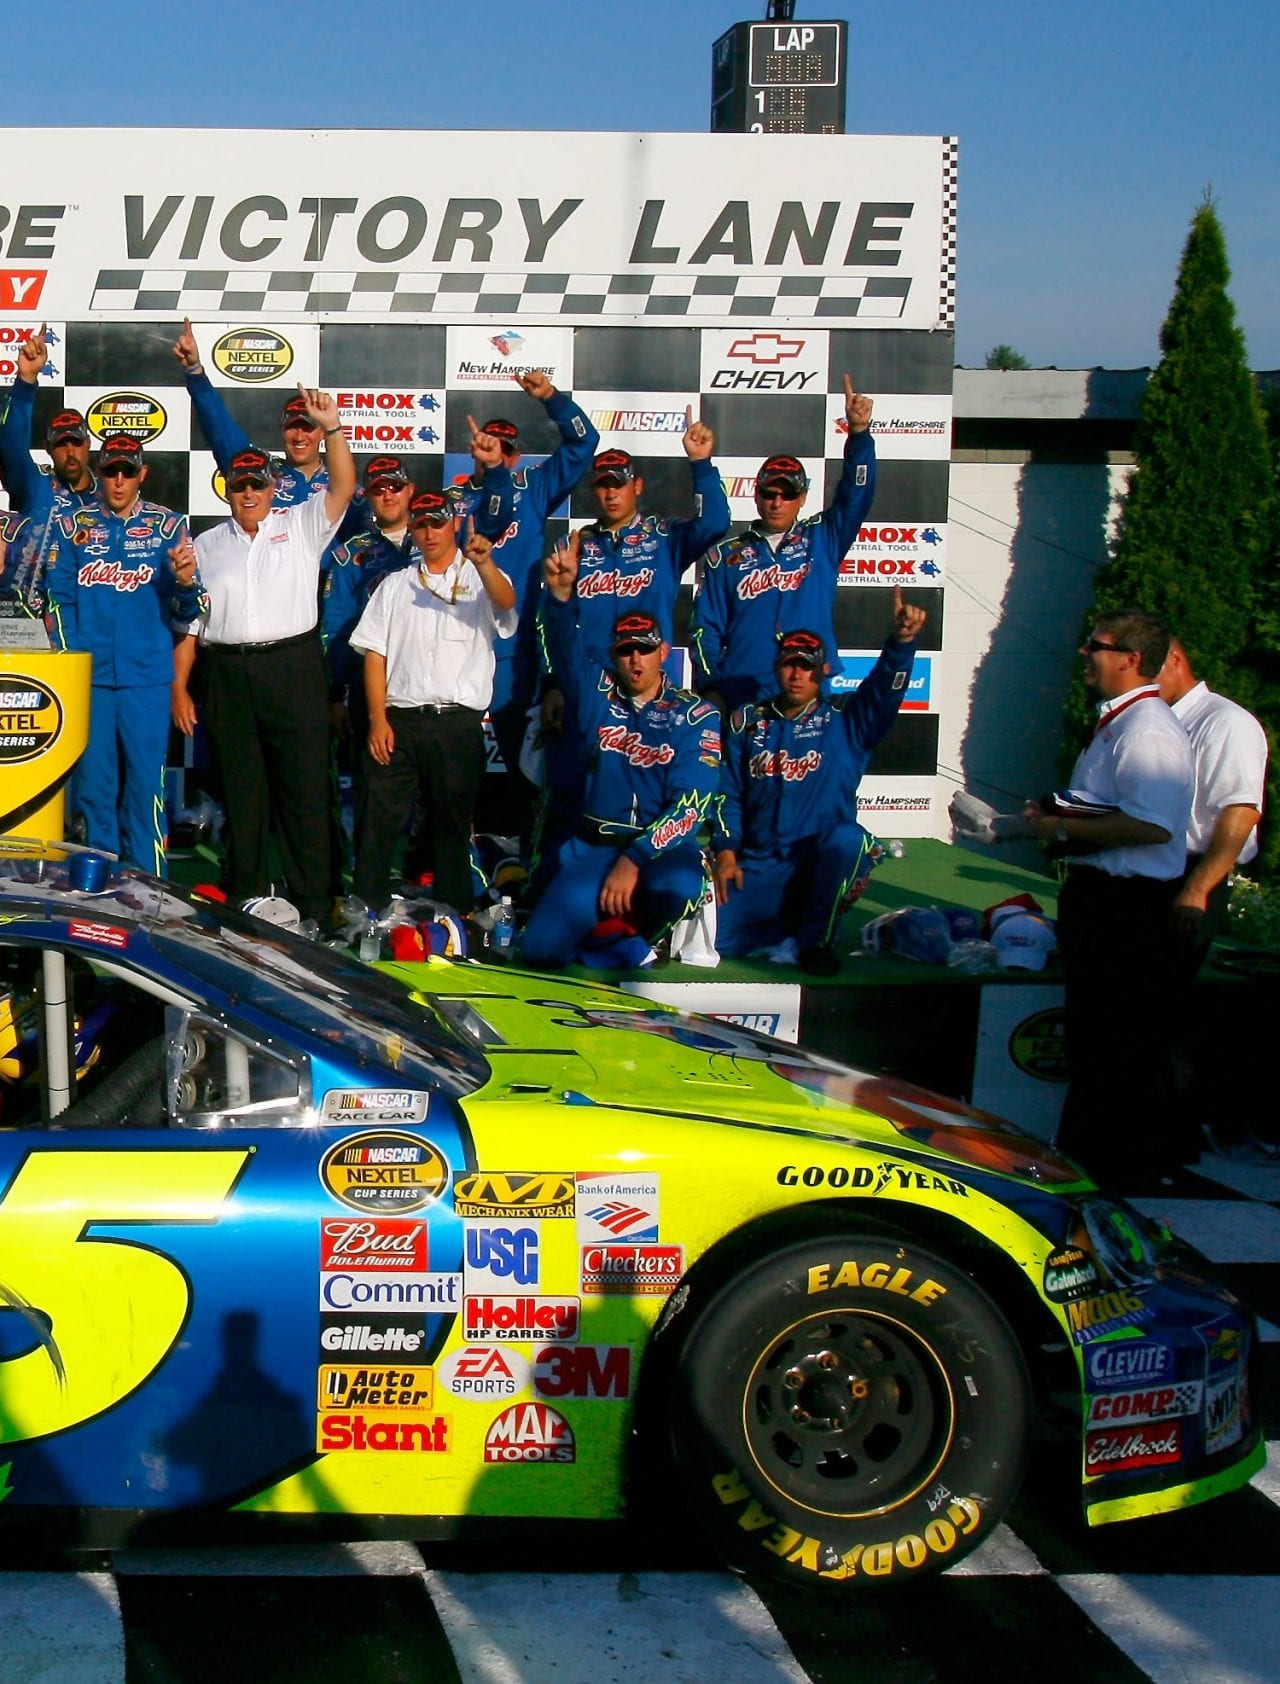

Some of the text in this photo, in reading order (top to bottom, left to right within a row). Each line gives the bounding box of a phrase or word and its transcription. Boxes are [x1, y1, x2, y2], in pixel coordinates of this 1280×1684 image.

[773, 28, 815, 51] LAP
[123, 195, 915, 266] VICTORY LANE
[242, 338, 278, 349] NASCAR
[228, 351, 279, 363] NEXTEL
[231, 365, 275, 373] CUP SERIES
[459, 362, 488, 373] NEW
[710, 370, 820, 390] CHEVY
[115, 402, 152, 414] NASCAR
[336, 393, 415, 410] ENOX
[101, 416, 152, 426] NEXTEL
[618, 412, 684, 431] NASCAR
[890, 419, 946, 428] HAMPSHIRE
[342, 425, 415, 441] ENOX
[384, 442, 416, 450] TOOLS
[858, 527, 918, 543] NOX
[78, 559, 153, 591] Kellogg's
[839, 559, 916, 575] ENOX
[577, 567, 654, 598] Kellogg's
[599, 725, 675, 767] Kellogg's
[750, 750, 822, 781] Kellogg's
[875, 796, 932, 805] HAMPSHIRE
[360, 1093, 413, 1108] NASCAR
[328, 1110, 415, 1121] RACE CAR
[366, 1147, 419, 1163] NASCAR
[347, 1168, 423, 1183] NEXTEL
[354, 1188, 418, 1199] CUP SERIES
[578, 1184, 656, 1194] Bank of America
[455, 1203, 575, 1217] MECHANIX WEAR
[324, 1221, 423, 1253] Bud
[466, 1228, 538, 1285] USG
[583, 1248, 676, 1274] Checkers
[324, 1273, 457, 1308] Commit
[806, 1260, 949, 1308] EAGLE
[467, 1298, 578, 1338] Holley
[1068, 1288, 1146, 1331] MOOG
[321, 1326, 421, 1352] Gillette
[467, 1330, 557, 1339] HP CARBS
[456, 1347, 511, 1378] EA
[1090, 1345, 1168, 1379] CLEVITE
[352, 1370, 415, 1387] Auto
[534, 1346, 630, 1398] 3M
[452, 1379, 516, 1394] SPORTS
[346, 1388, 428, 1408] Meter
[1093, 1389, 1175, 1421] COMP
[490, 1405, 570, 1443] MAC
[322, 1416, 448, 1452] Stant
[486, 1446, 573, 1461] TOOLS
[1088, 1430, 1178, 1465] Edelbrock
